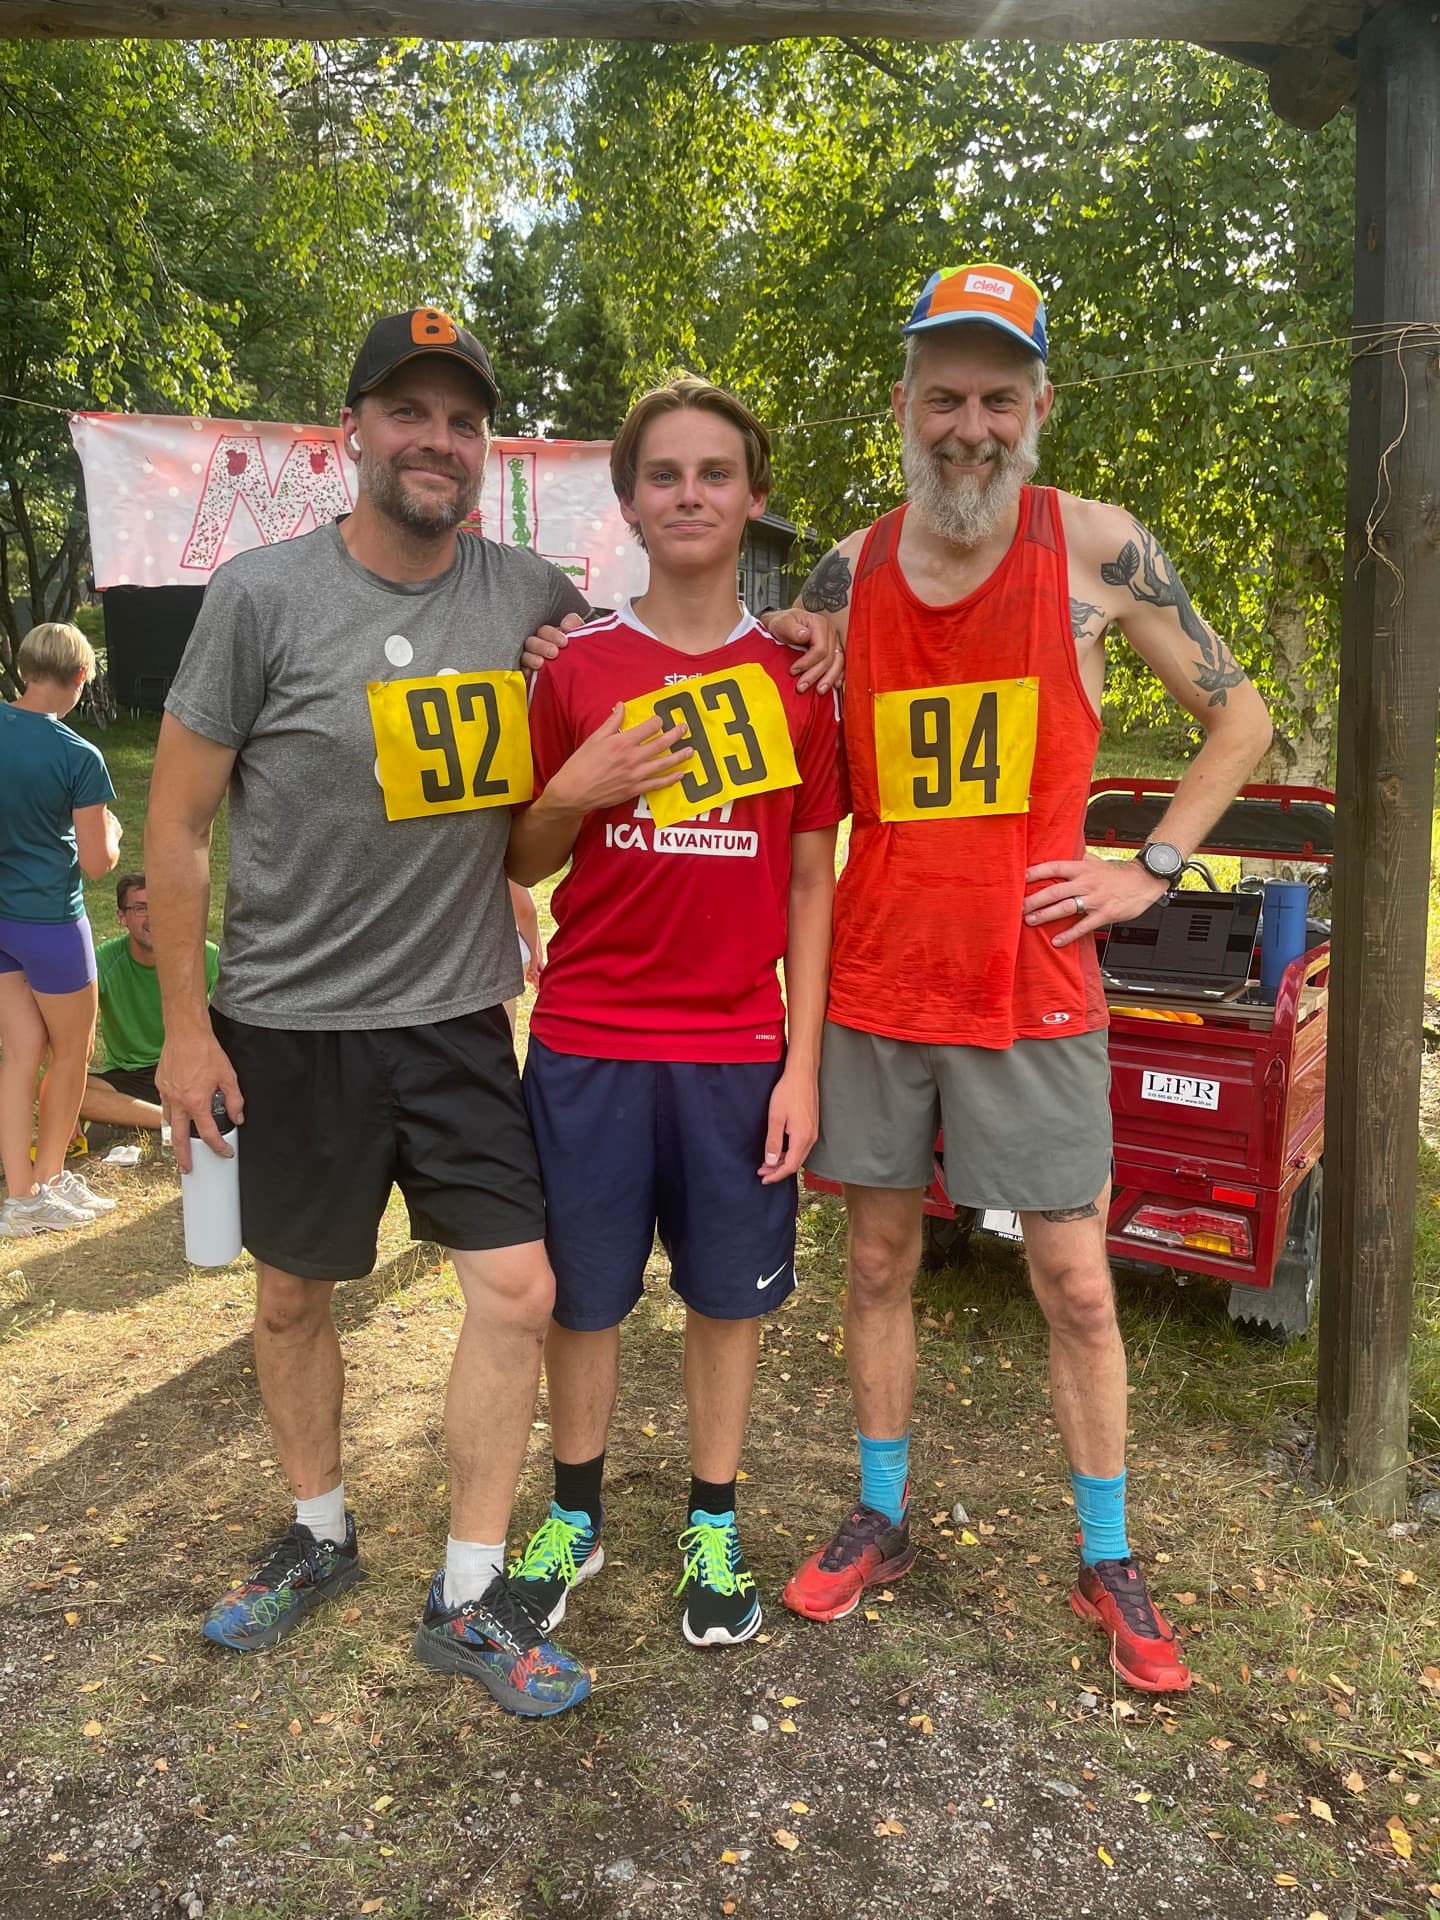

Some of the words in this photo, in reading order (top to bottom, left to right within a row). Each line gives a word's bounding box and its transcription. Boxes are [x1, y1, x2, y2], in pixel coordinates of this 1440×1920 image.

[406, 682, 510, 803] 92
[653, 678, 768, 804] 93
[909, 691, 1001, 809] 94
[605, 823, 648, 851] ICA
[660, 831, 753, 851] KVANTUM
